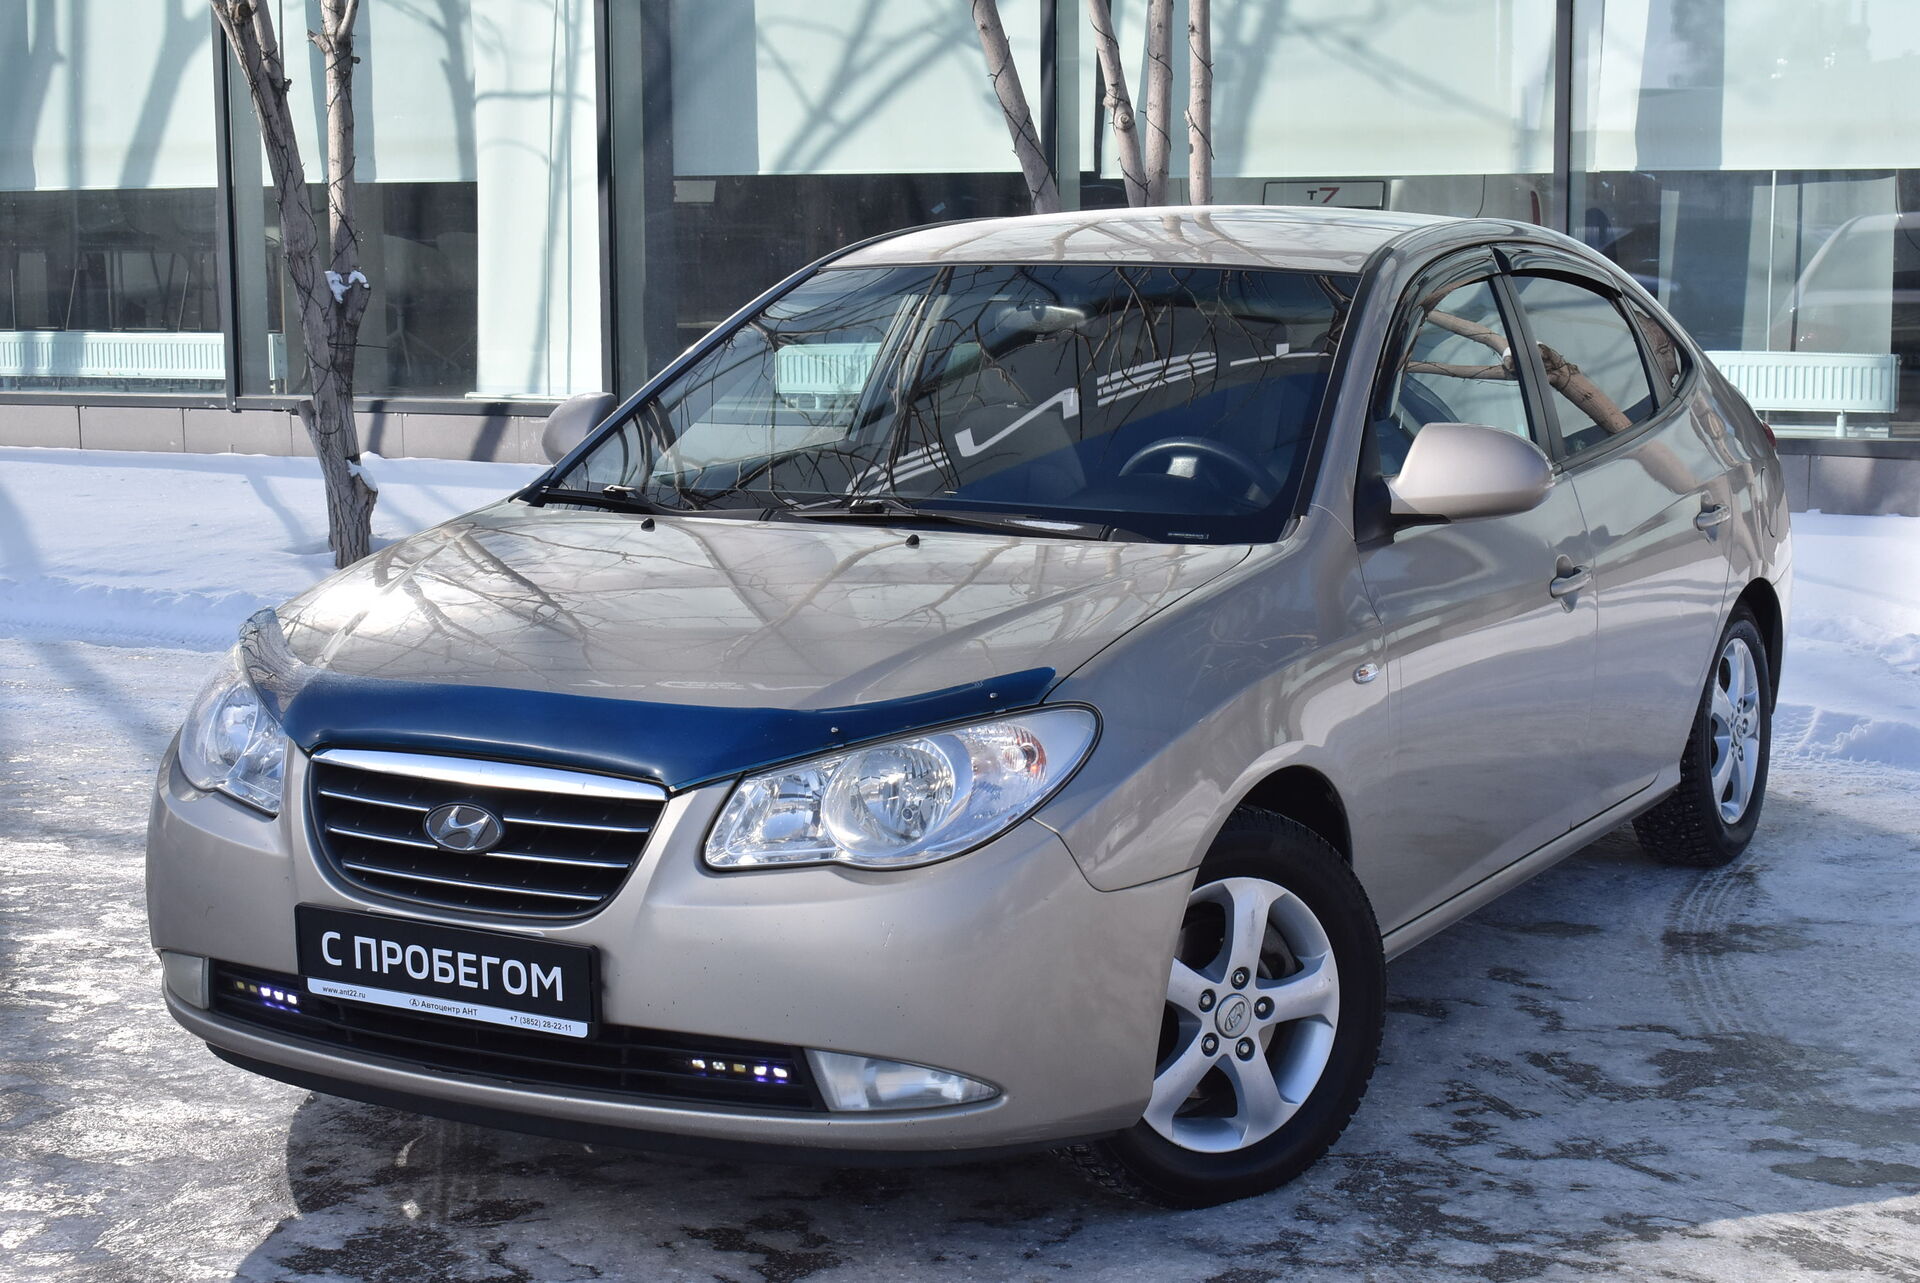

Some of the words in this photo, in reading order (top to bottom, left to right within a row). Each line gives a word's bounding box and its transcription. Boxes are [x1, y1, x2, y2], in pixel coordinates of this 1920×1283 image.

[321, 931, 342, 967] С
[354, 935, 563, 1002] ПРОБЕГОМ
[322, 986, 366, 999] www.ant22.ru
[421, 1000, 461, 1014] Автоцентр
[462, 1007, 478, 1016] АНТ
[519, 1016, 541, 1029] (3852)
[542, 1020, 572, 1032] 28-22-11
